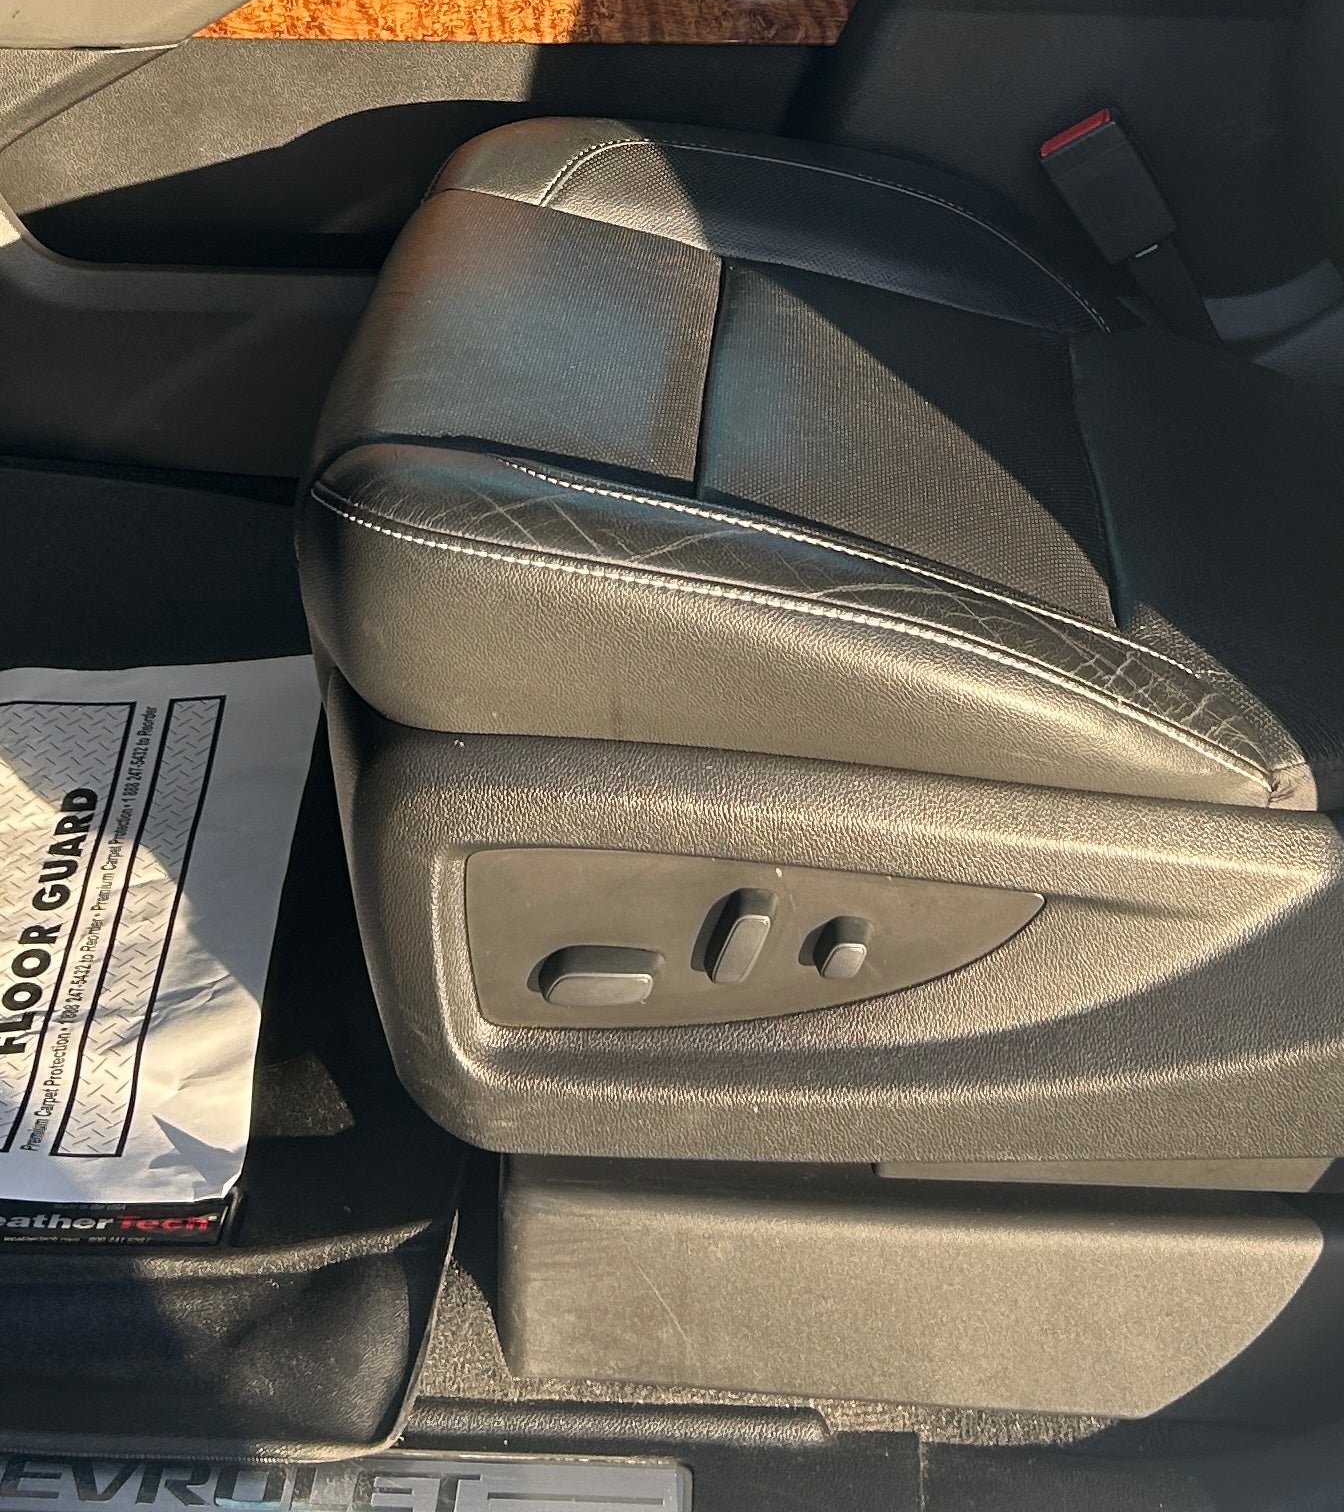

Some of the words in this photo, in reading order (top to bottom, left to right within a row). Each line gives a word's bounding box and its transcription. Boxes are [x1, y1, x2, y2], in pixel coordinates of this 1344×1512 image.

[136, 706, 157, 735] Reorder
[107, 808, 132, 844] Protection
[32, 787, 98, 911] GUARD
[99, 846, 122, 870] Carpet
[90, 873, 113, 910] Premium
[81, 919, 103, 950] Reorder
[65, 964, 92, 1002] 247-5432
[43, 1032, 71, 1085] Protection
[33, 1088, 62, 1116] Carpet
